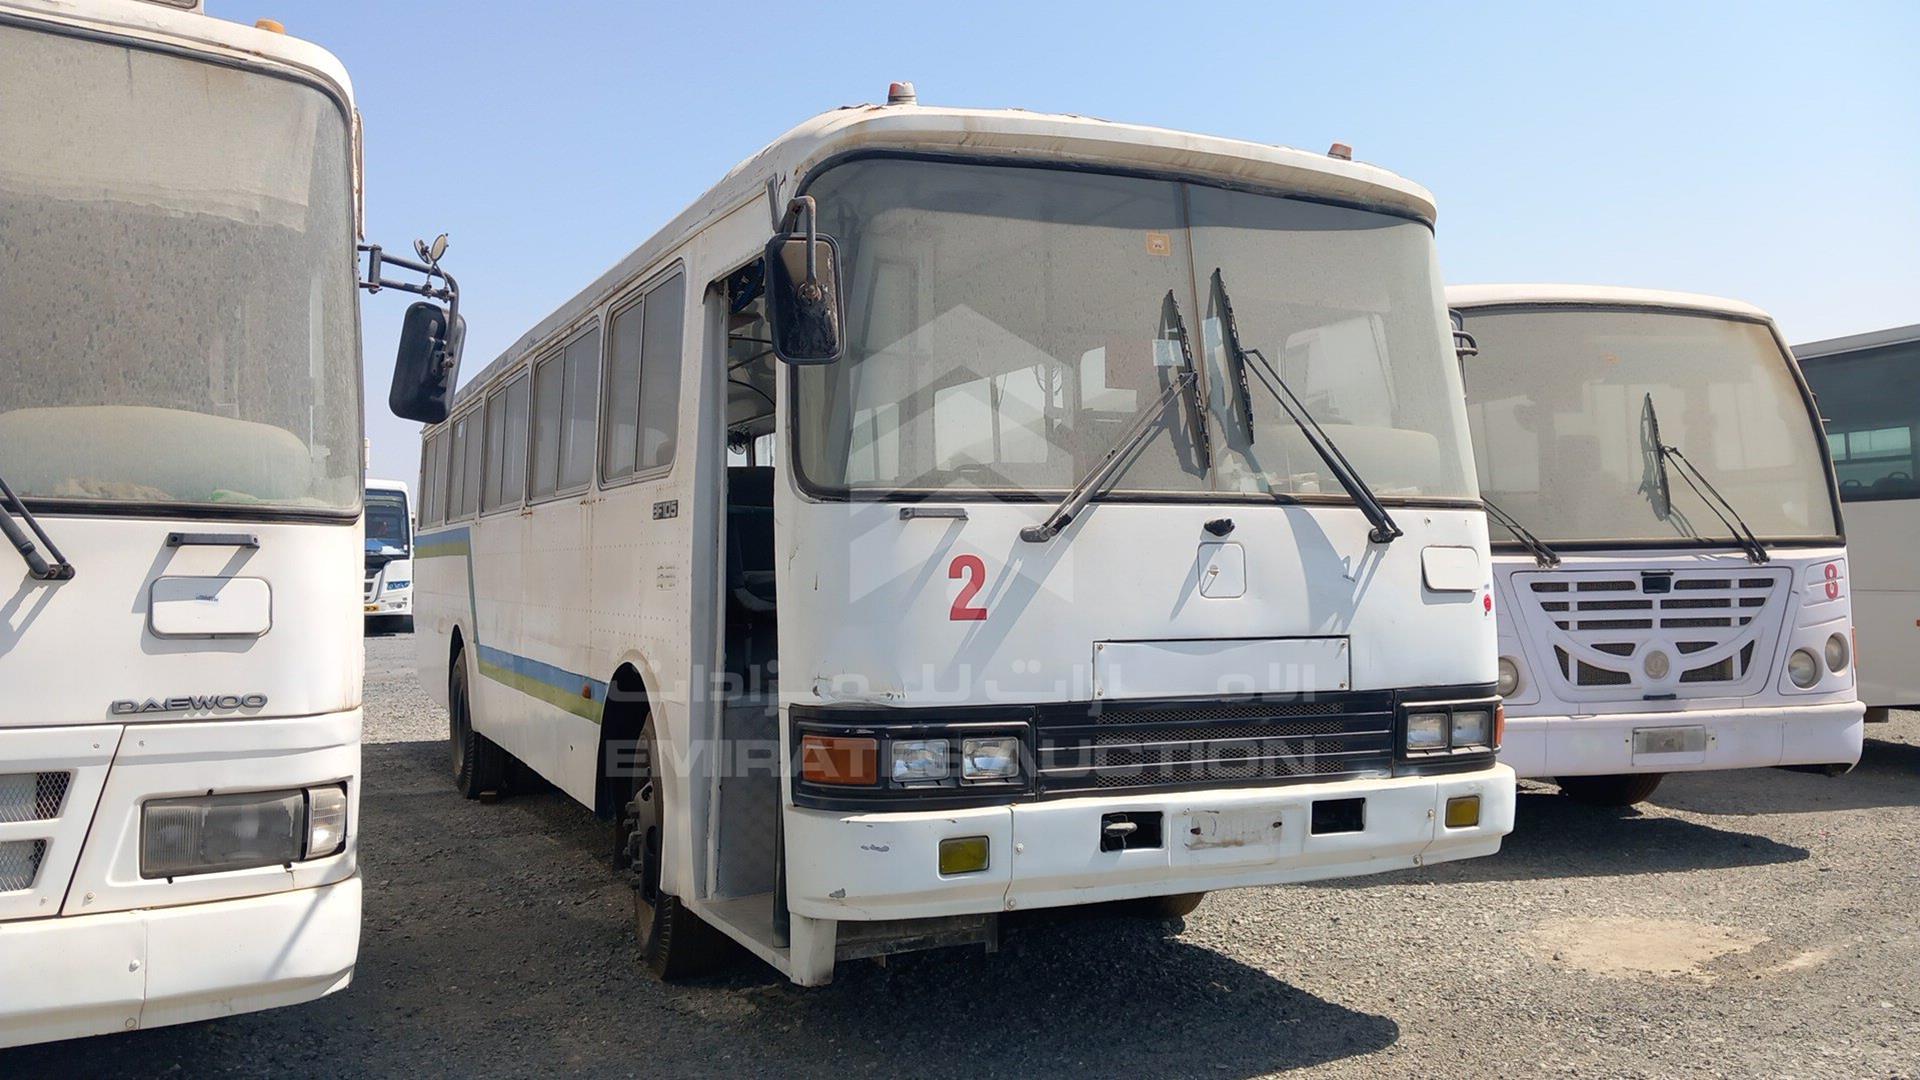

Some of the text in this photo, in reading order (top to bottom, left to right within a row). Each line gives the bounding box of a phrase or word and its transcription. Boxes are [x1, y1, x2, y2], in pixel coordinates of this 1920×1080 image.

[948, 554, 987, 621] 2
[1824, 563, 1839, 602] 8
[111, 692, 268, 715] DAEWOO
